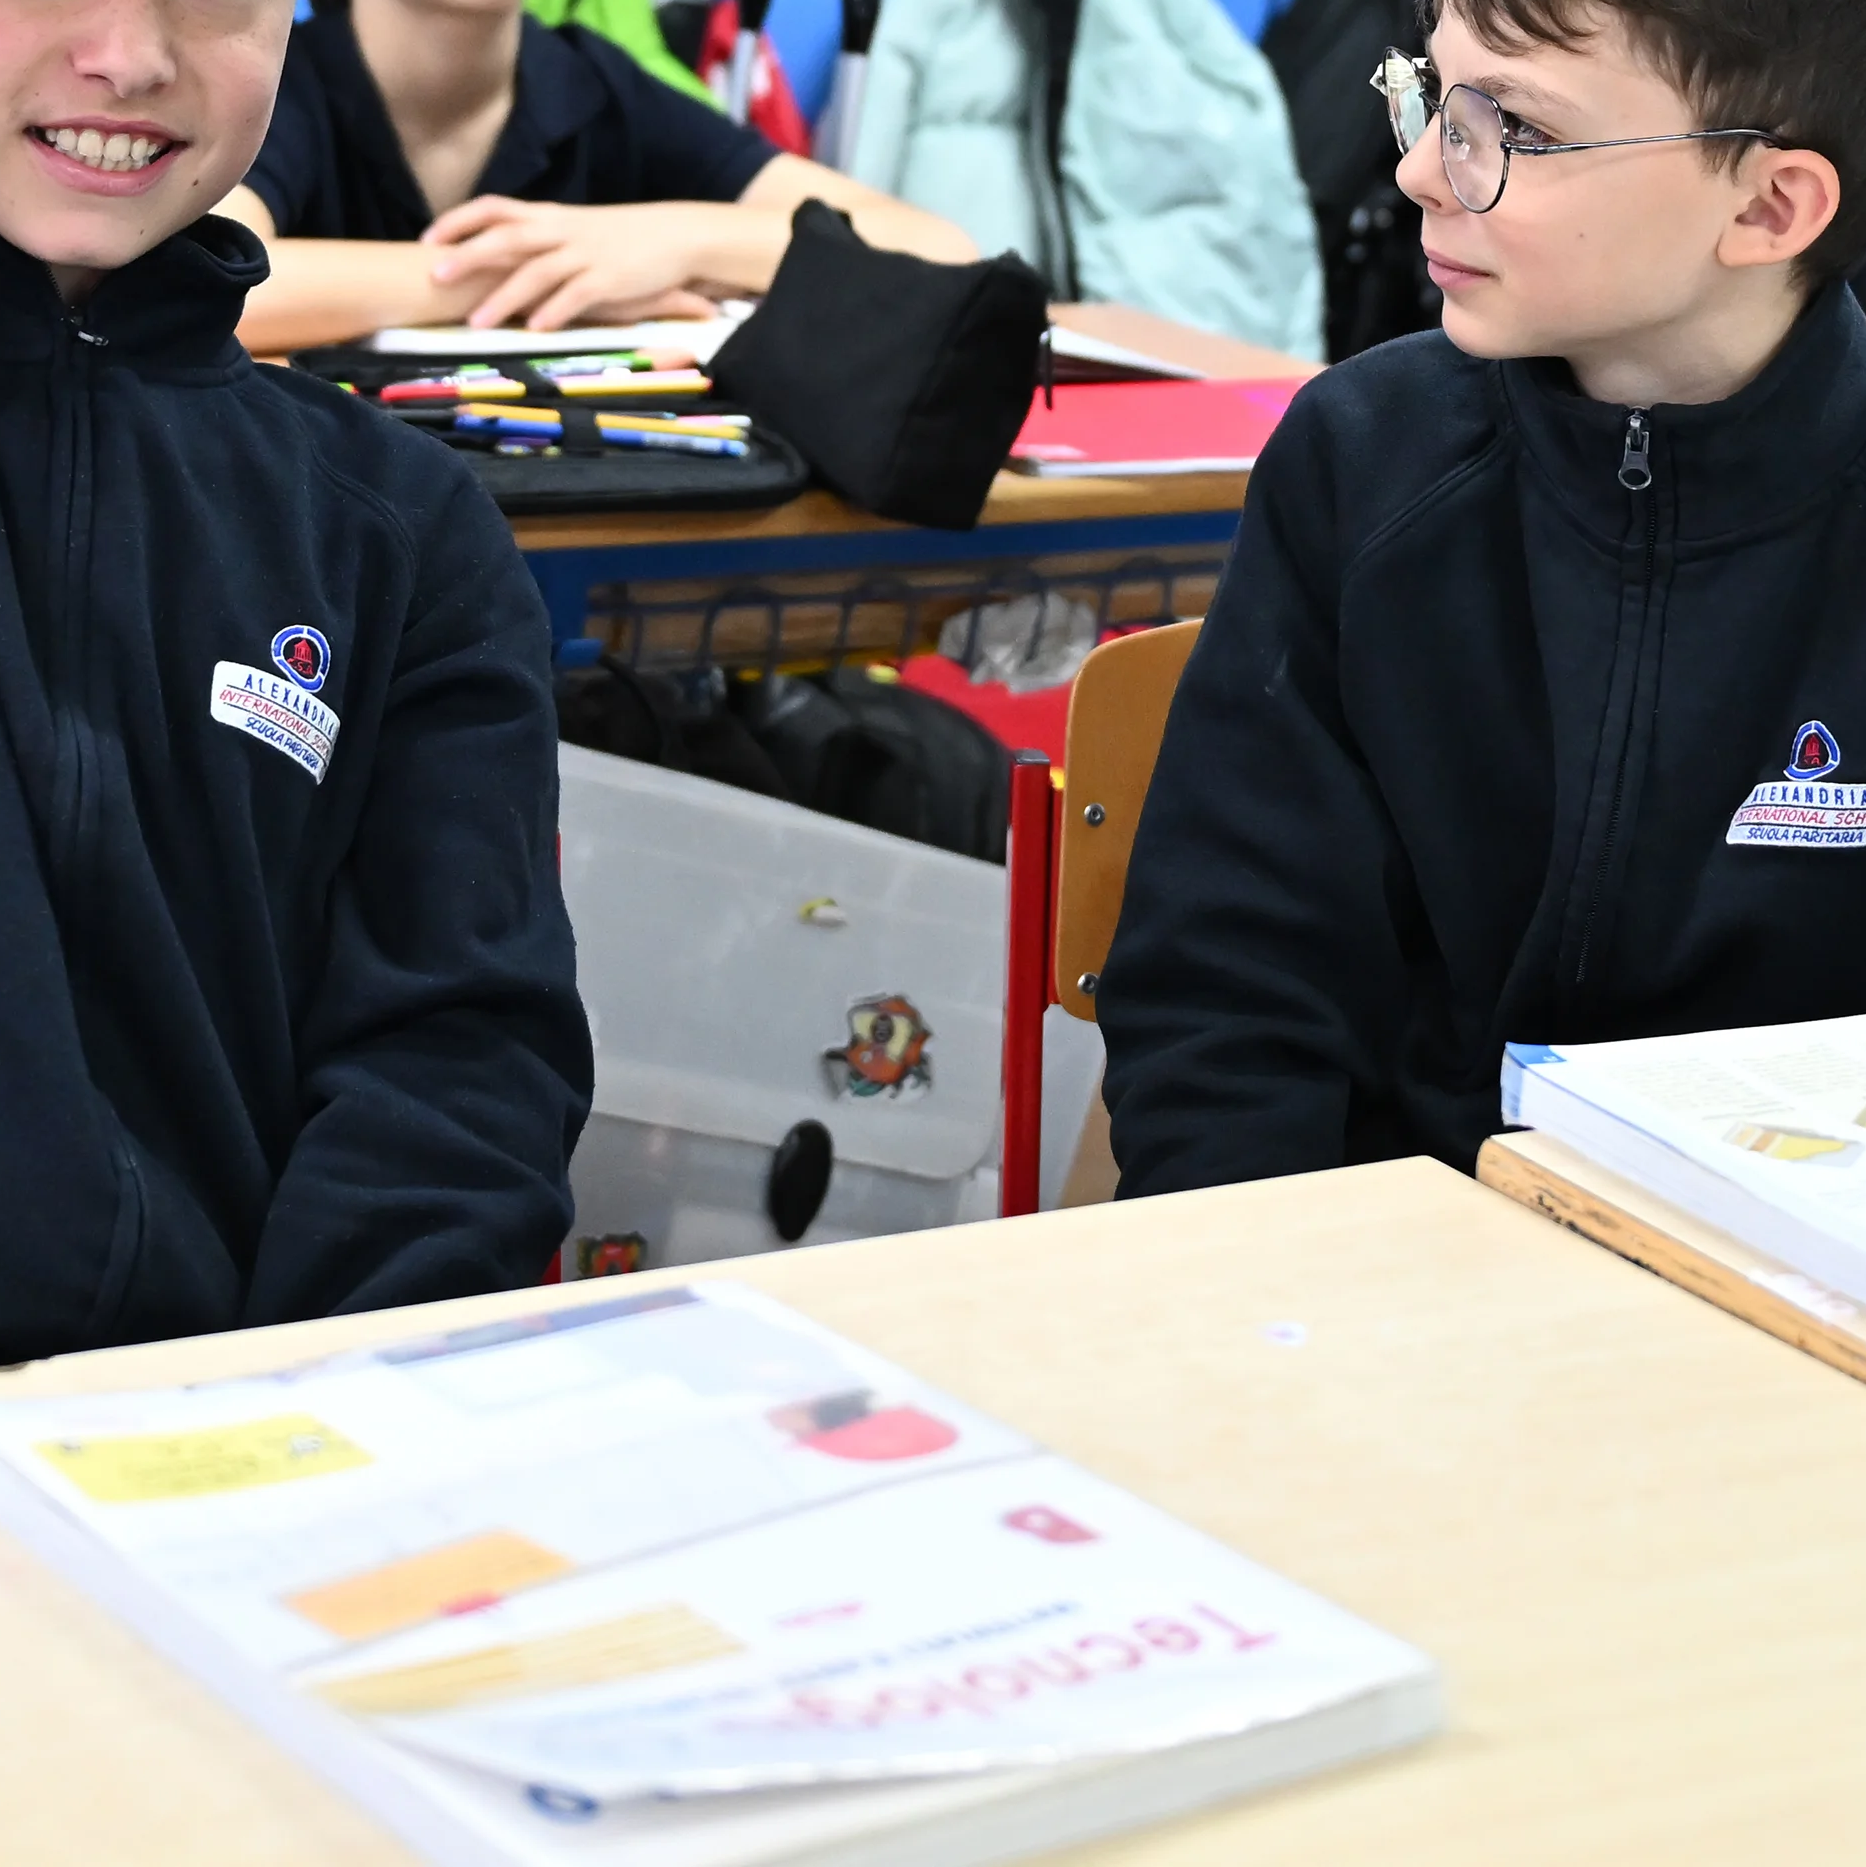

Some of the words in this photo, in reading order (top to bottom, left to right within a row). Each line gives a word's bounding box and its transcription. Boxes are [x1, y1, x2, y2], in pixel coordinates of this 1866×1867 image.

[219, 689, 309, 741] INTERNATIONAL
[245, 716, 283, 745] SCUOLA
[1734, 807, 1828, 825] INTERNATIONAL
[1746, 827, 1789, 841] SCUOLA
[1792, 828, 1864, 844] PARITARIA
